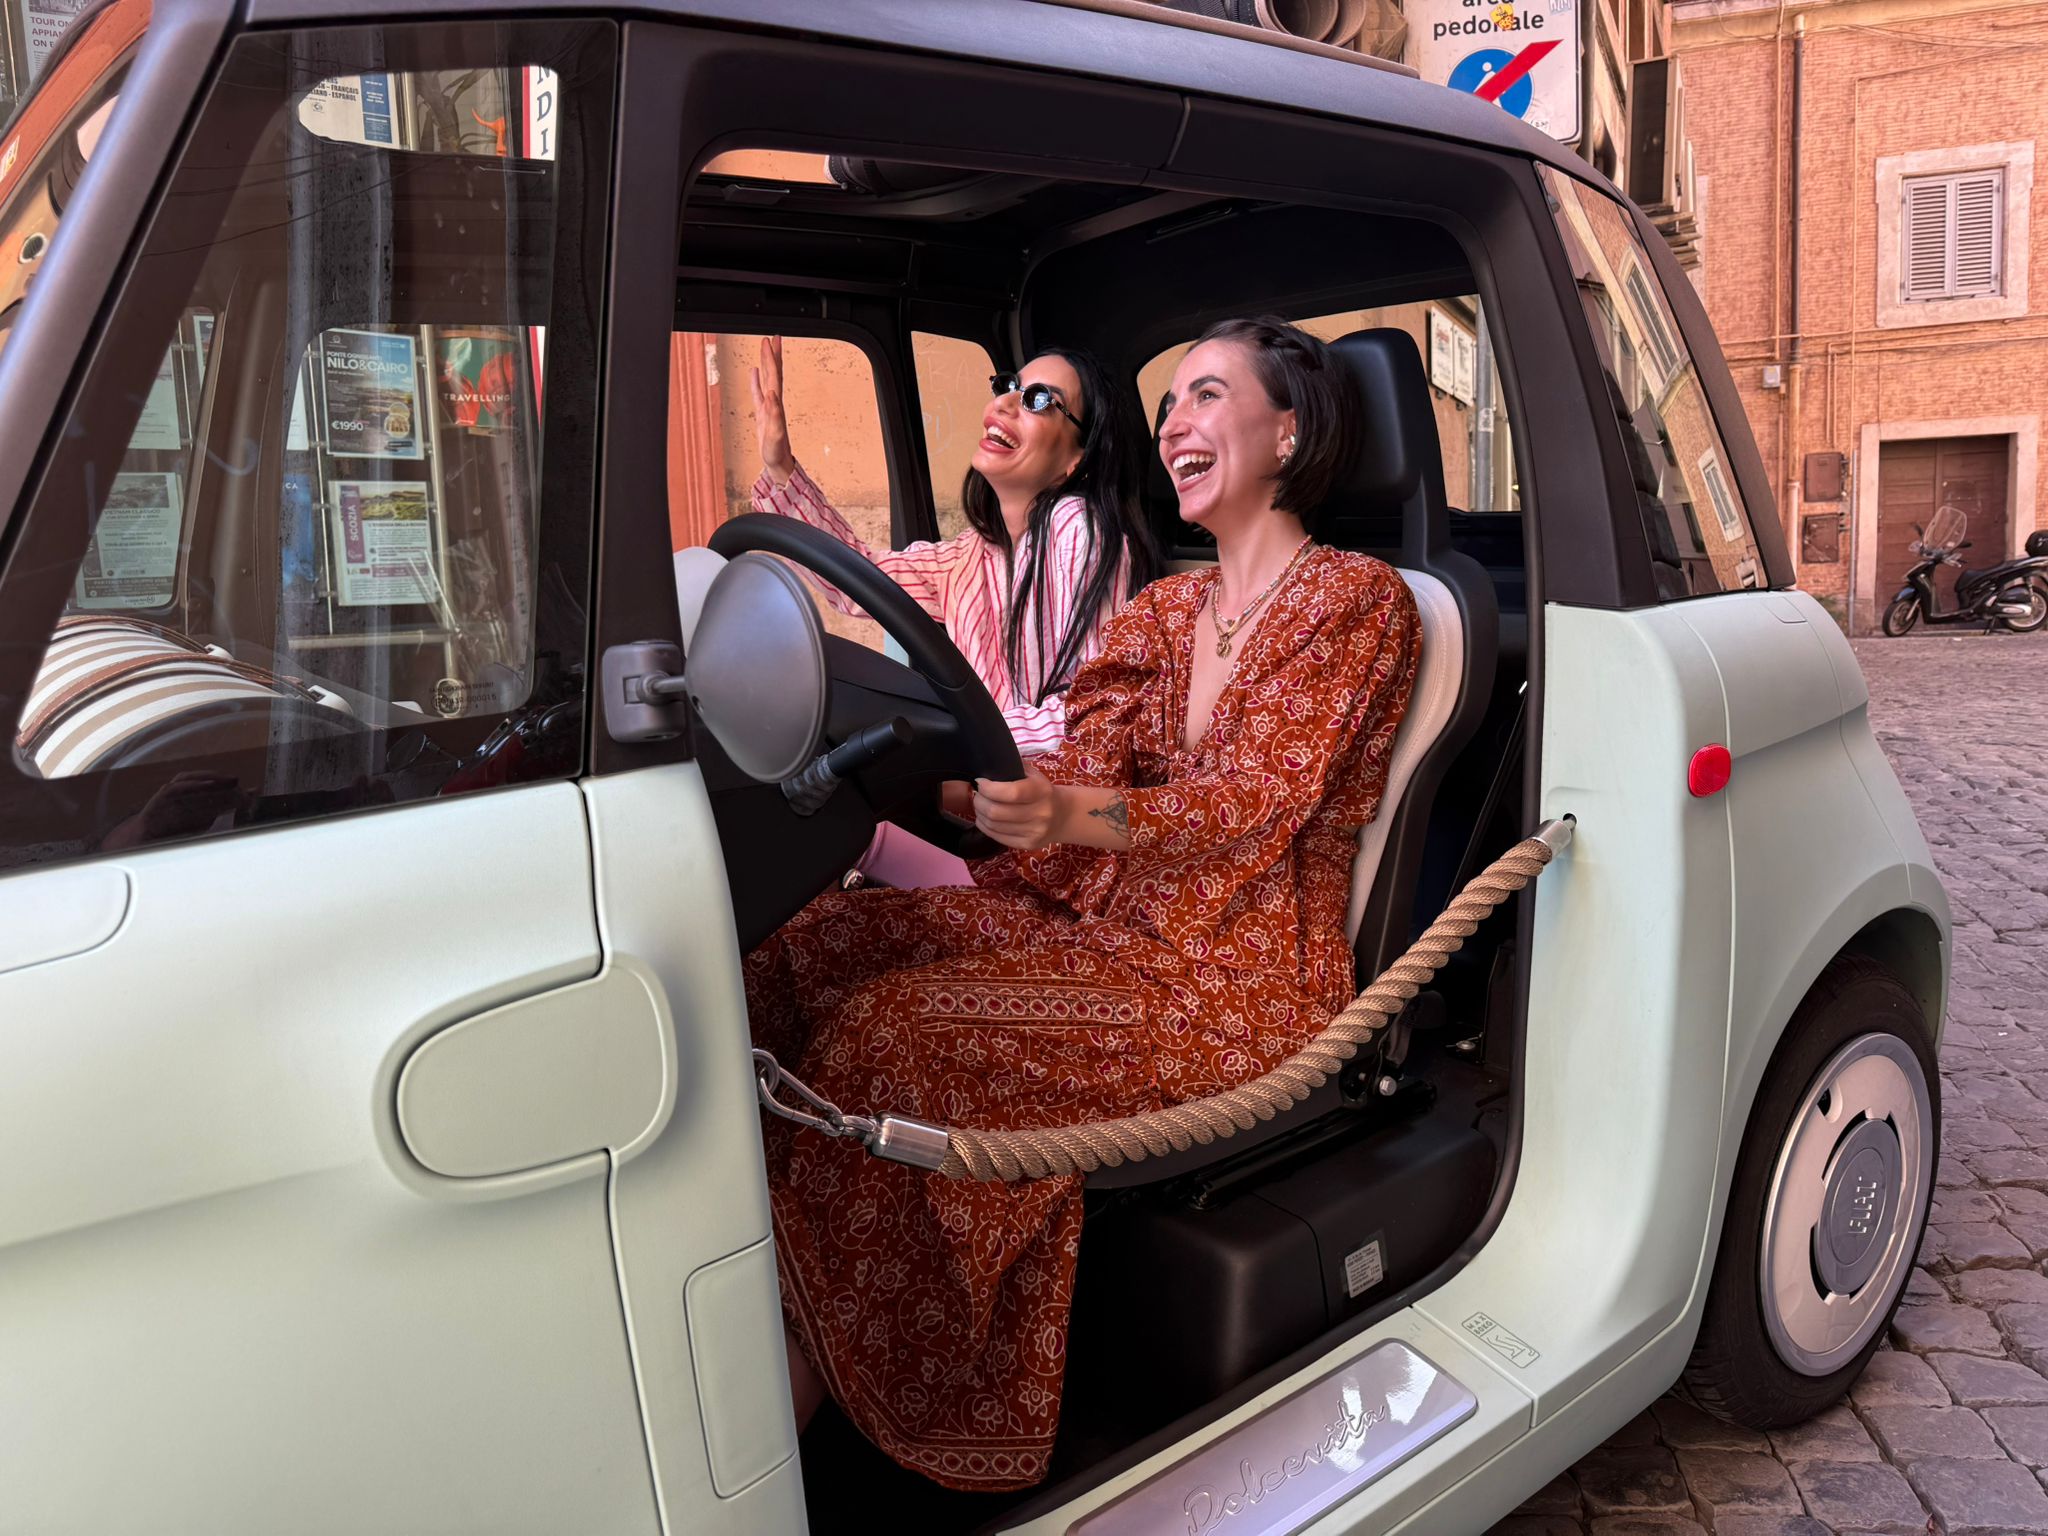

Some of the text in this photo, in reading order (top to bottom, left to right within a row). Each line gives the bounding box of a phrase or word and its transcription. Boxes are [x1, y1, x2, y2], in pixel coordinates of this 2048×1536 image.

[30, 17, 56, 26] TOUR
[331, 84, 359, 94] FRANÇAIS
[327, 357, 408, 374] NILO&CAIRO
[444, 392, 511, 402] TRAVELLING
[331, 420, 364, 431] €1990
[348, 504, 359, 541] SCOZIA
[1466, 1315, 1486, 1329] MAX
[1184, 1400, 1385, 1536] Dolcevita
